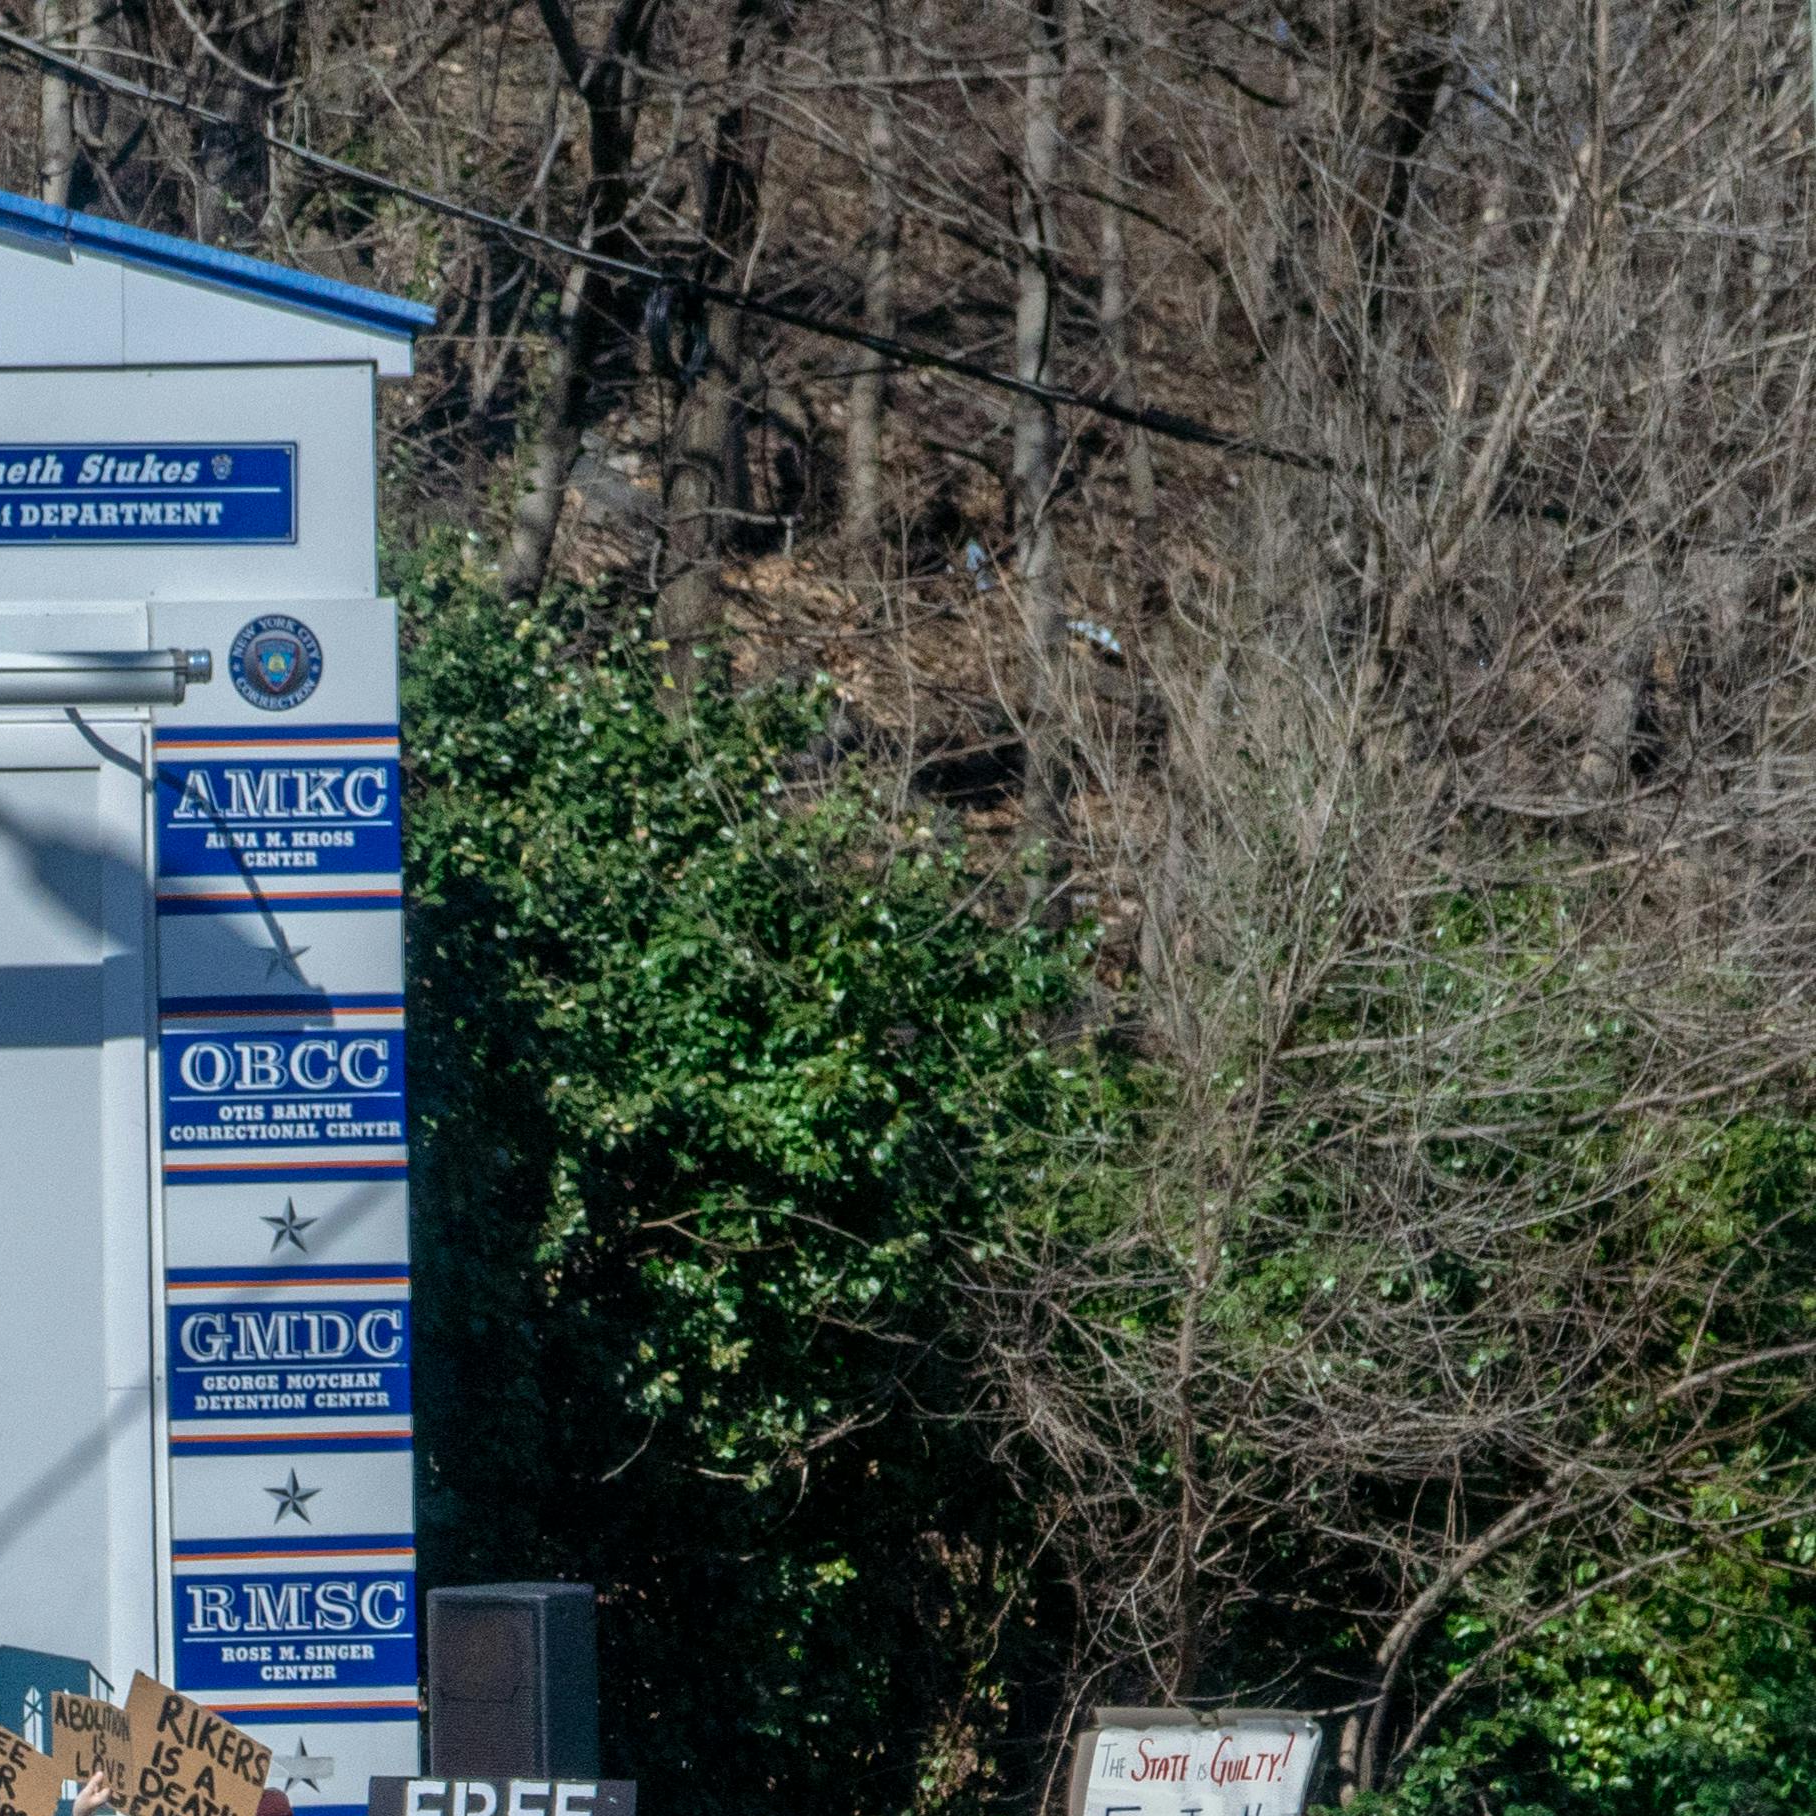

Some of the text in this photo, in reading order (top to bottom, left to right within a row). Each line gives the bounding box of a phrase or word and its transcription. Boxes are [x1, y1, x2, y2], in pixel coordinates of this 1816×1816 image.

[77, 454, 200, 484] Stukes
[20, 502, 223, 526] DEPARTMENT
[233, 616, 320, 658] NEW YORK CITY
[236, 677, 315, 709] CORRECTION
[173, 767, 386, 818] AMKC
[205, 831, 354, 848] ANNA M. KROSS
[243, 852, 317, 867] CENTER
[180, 1039, 388, 1092] OBCC
[219, 1104, 352, 1121] OTIS BANTUM
[170, 1122, 401, 1141] CORRECTIONAL CENTER
[180, 1310, 403, 1362] GMDC
[203, 1373, 381, 1391] GEORGE MOTCHAN
[195, 1392, 389, 1411] DETENTION CENTER
[186, 1581, 405, 1633] RMSC
[222, 1645, 374, 1662] ROSE M. SINGER
[261, 1665, 336, 1680] CENTER
[54, 1696, 131, 1742] ABOLITION
[93, 1735, 106, 1754] IS
[156, 1694, 270, 1787] RIKERS
[75, 1751, 125, 1790] LOVE
[151, 1741, 216, 1799] IS A
[1100, 1742, 1125, 1778] THE
[1131, 1737, 1190, 1782] STATE
[1210, 1733, 1295, 1787] GUILTY!
